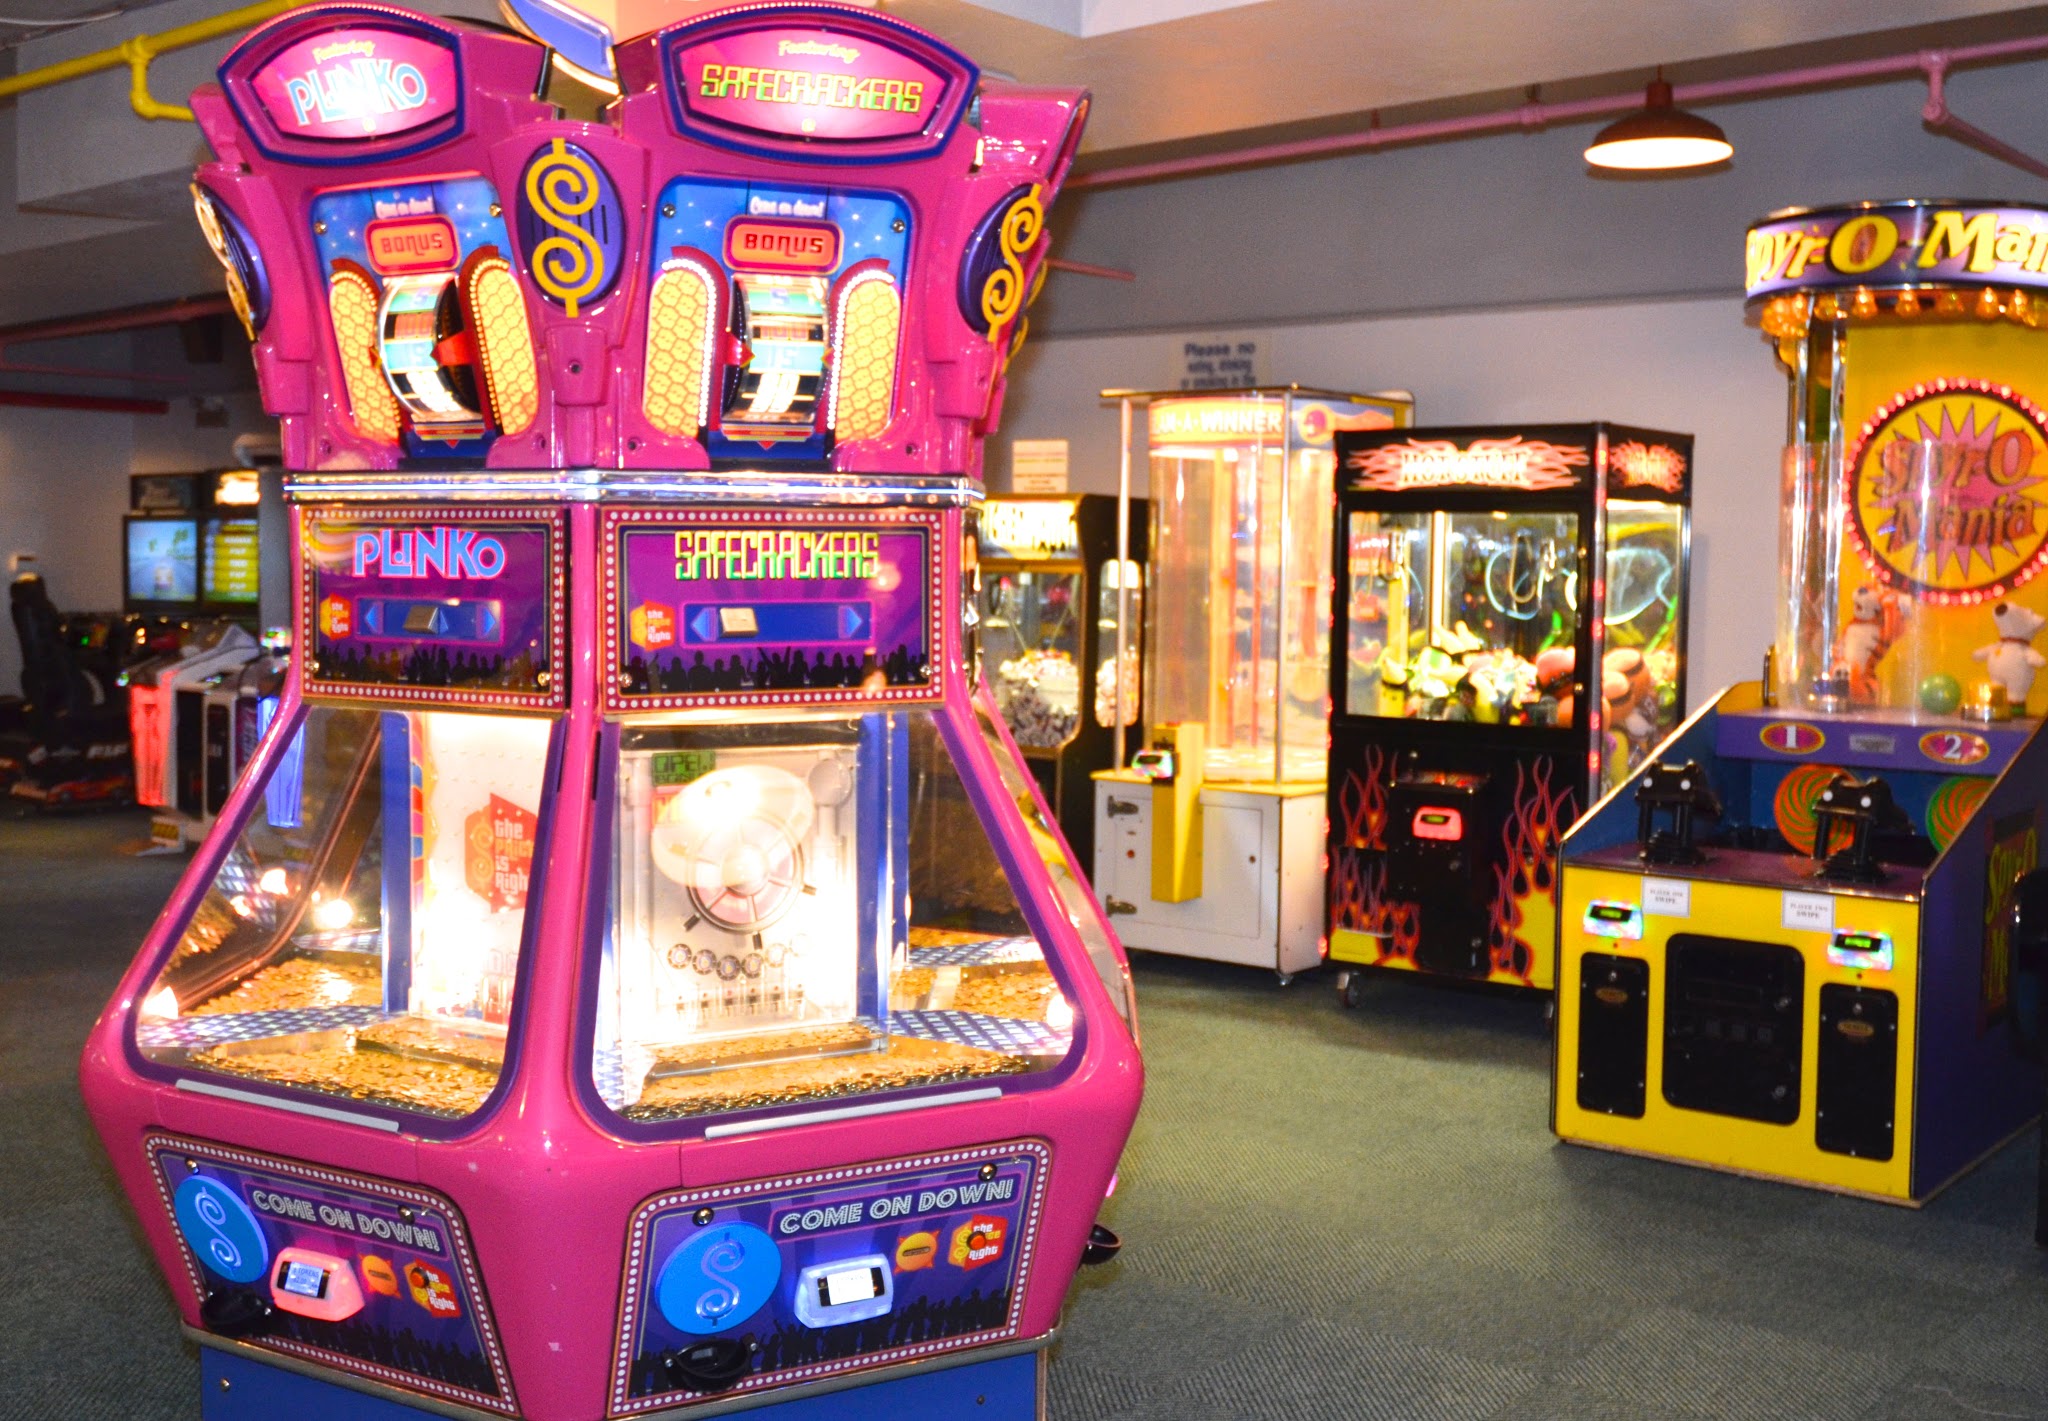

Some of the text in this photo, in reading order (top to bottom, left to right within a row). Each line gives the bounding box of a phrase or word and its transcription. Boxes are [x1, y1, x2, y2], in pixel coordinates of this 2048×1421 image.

[777, 40, 860, 64] Featuring
[288, 58, 427, 126] PLINKO
[700, 64, 924, 112] SAFECRACKERS
[380, 233, 442, 256] BONUS
[744, 233, 824, 258] BONUS
[352, 525, 508, 580] PLINKO
[674, 530, 880, 580] SAFECRACKERS
[1785, 725, 1798, 748] 1
[1943, 734, 1963, 759] 2
[494, 818, 523, 840] the
[495, 855, 509, 872] is
[495, 867, 529, 895] Righ
[780, 1179, 1014, 1234] COME ON DOWN!
[253, 1190, 440, 1252] COME ON DOWN!
[973, 1223, 993, 1234] the
[968, 1244, 998, 1260] Right
[430, 1296, 456, 1311] Right
